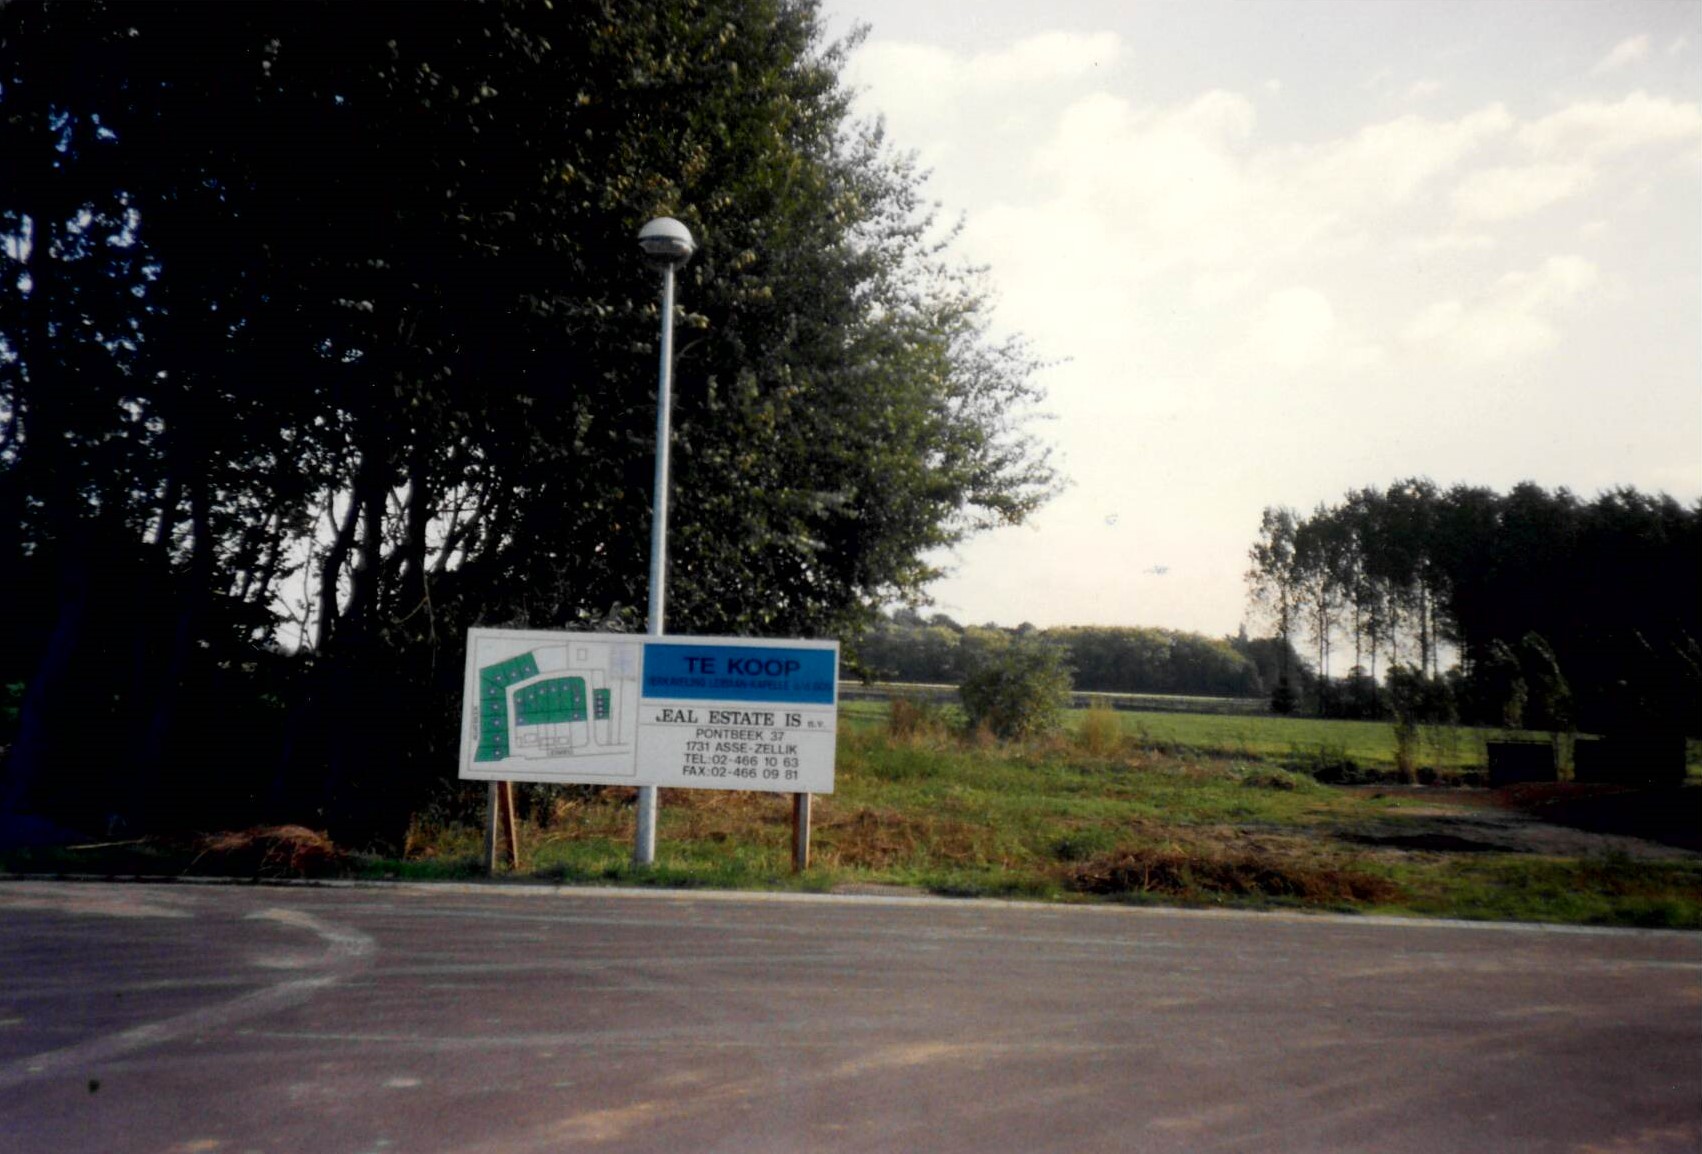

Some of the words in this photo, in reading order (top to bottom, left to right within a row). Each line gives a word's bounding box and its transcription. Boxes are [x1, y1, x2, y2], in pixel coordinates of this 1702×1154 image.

[684, 656, 715, 674] TE
[727, 658, 800, 676] KOOP
[656, 708, 698, 723] EAL
[709, 710, 774, 727] ESTATE
[785, 713, 802, 727] IS
[696, 728, 763, 741] PONTBEEK
[770, 731, 784, 742] 37
[686, 741, 709, 752] 1731
[715, 742, 797, 755] ASSE-ZELLIK
[765, 757, 778, 767] 10
[783, 757, 799, 768] 63
[763, 768, 779, 780] 09
[785, 769, 798, 780] 81
